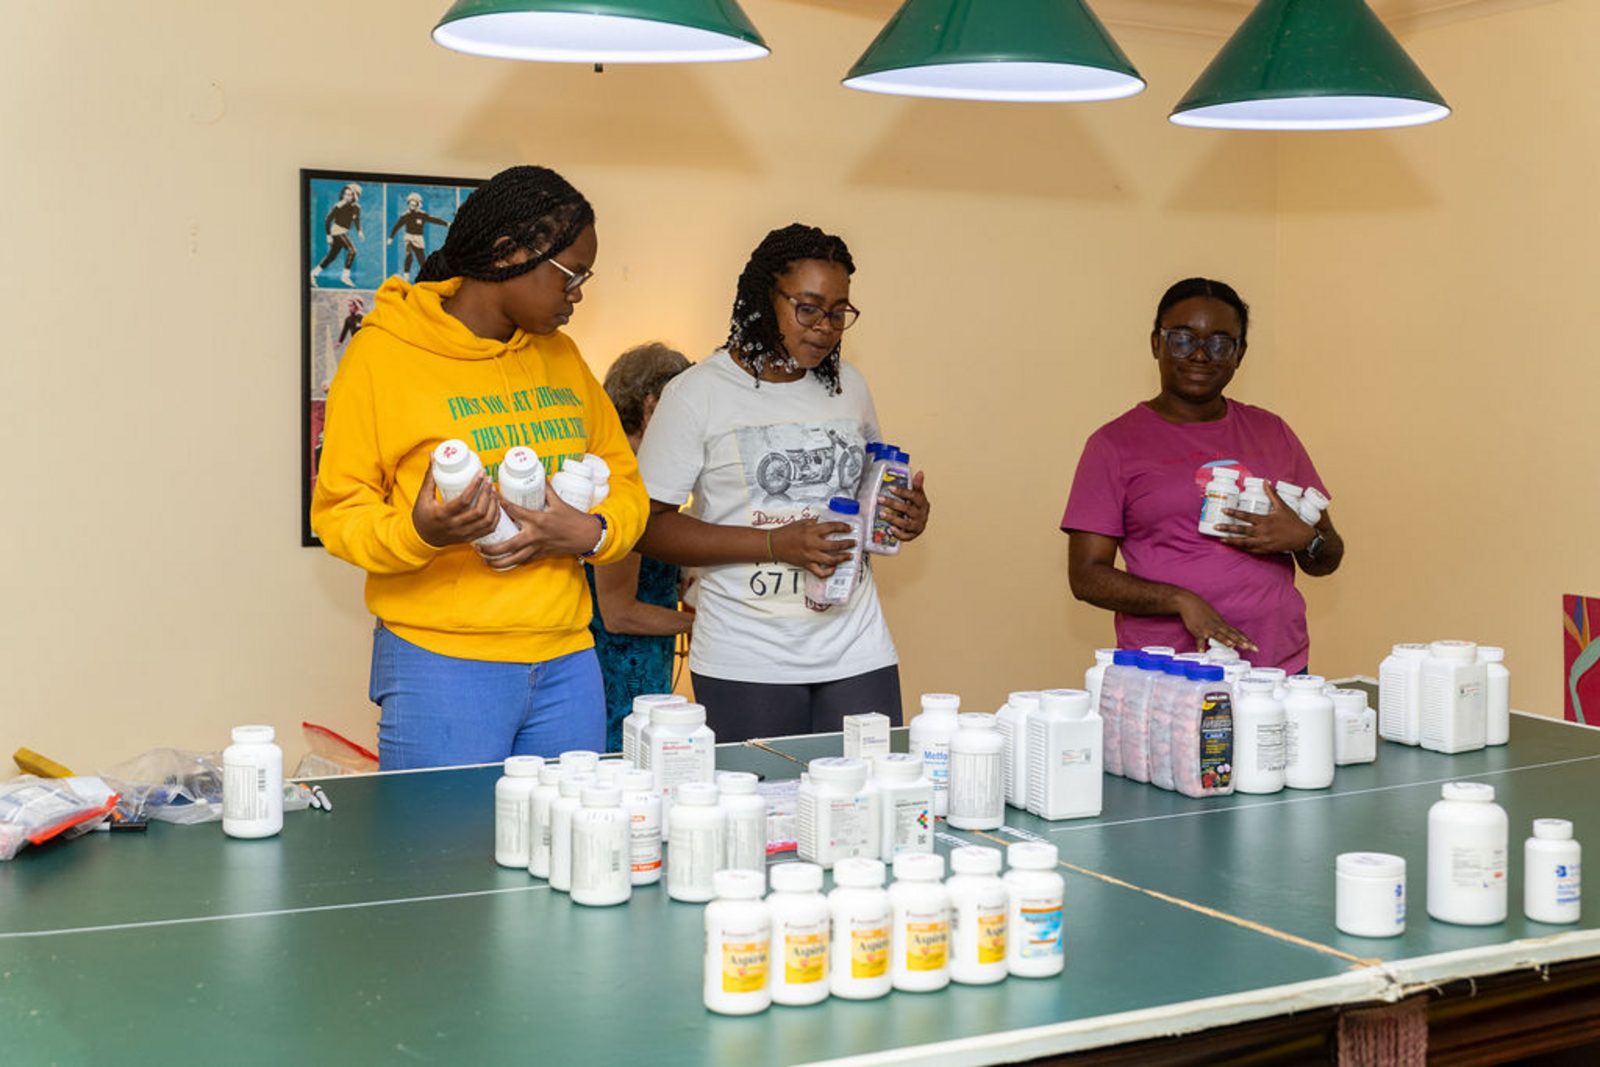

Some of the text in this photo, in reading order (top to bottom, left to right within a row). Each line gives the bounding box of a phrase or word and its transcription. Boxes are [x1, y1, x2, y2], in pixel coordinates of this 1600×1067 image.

[448, 396, 486, 420] FIRST
[505, 423, 530, 447] TE
[924, 751, 949, 761] Metfo
